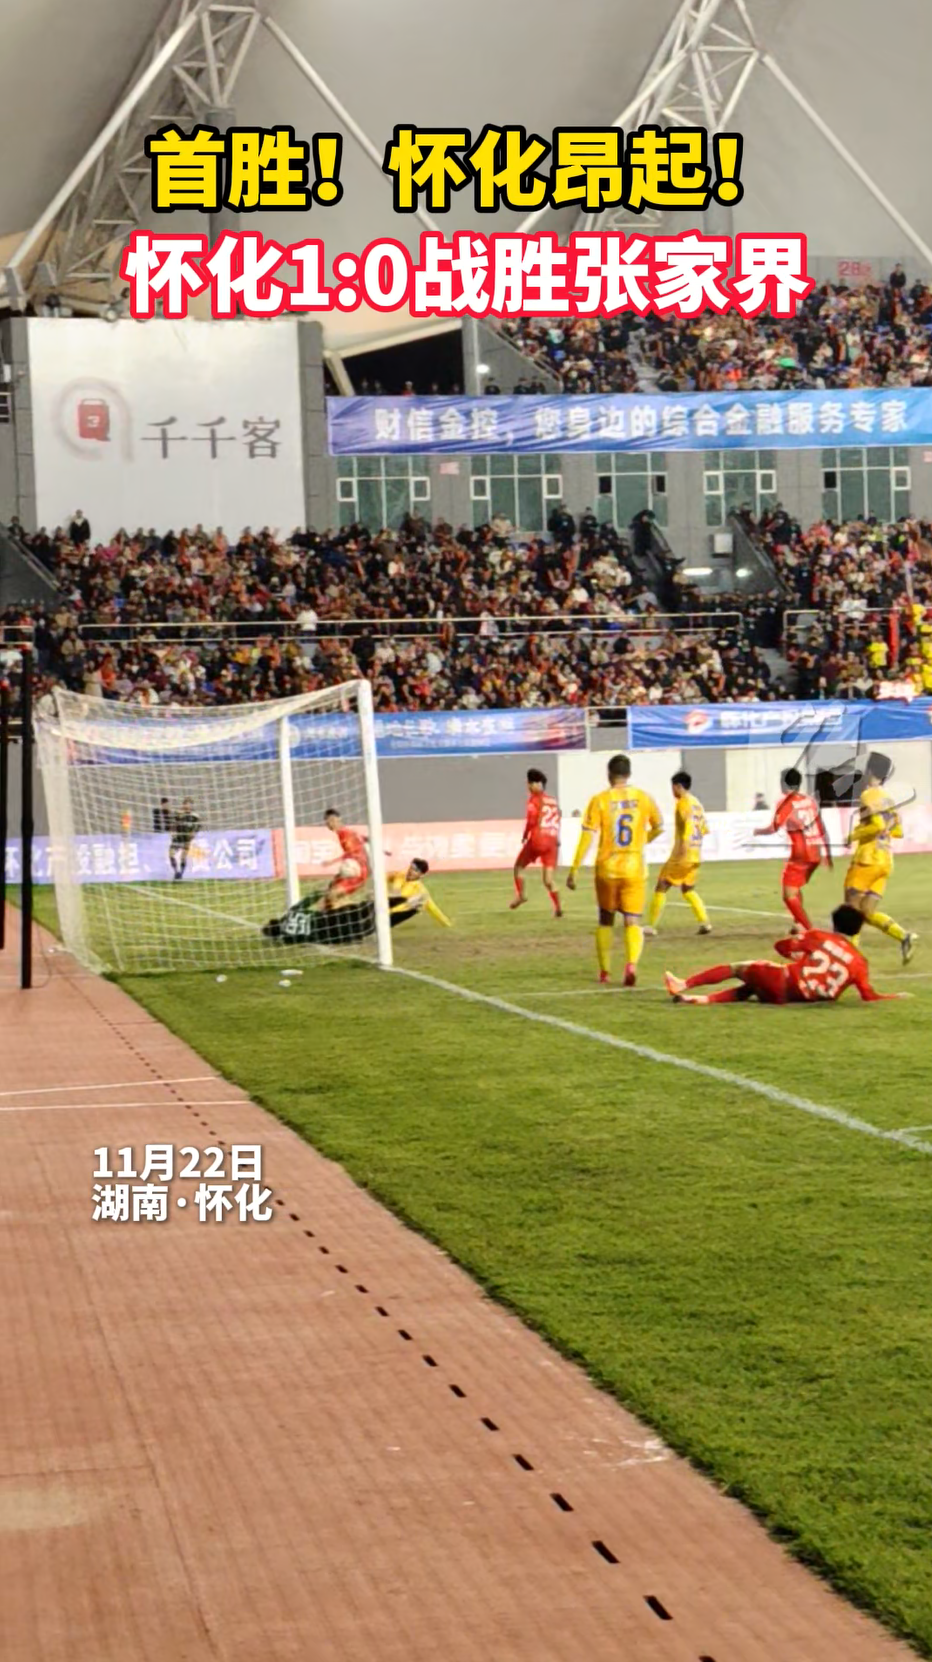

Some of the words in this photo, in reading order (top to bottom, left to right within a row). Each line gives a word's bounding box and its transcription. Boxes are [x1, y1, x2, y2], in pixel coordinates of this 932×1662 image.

[140, 415, 282, 460] 千千客
[616, 813, 634, 847] 6
[802, 949, 850, 998] 23
